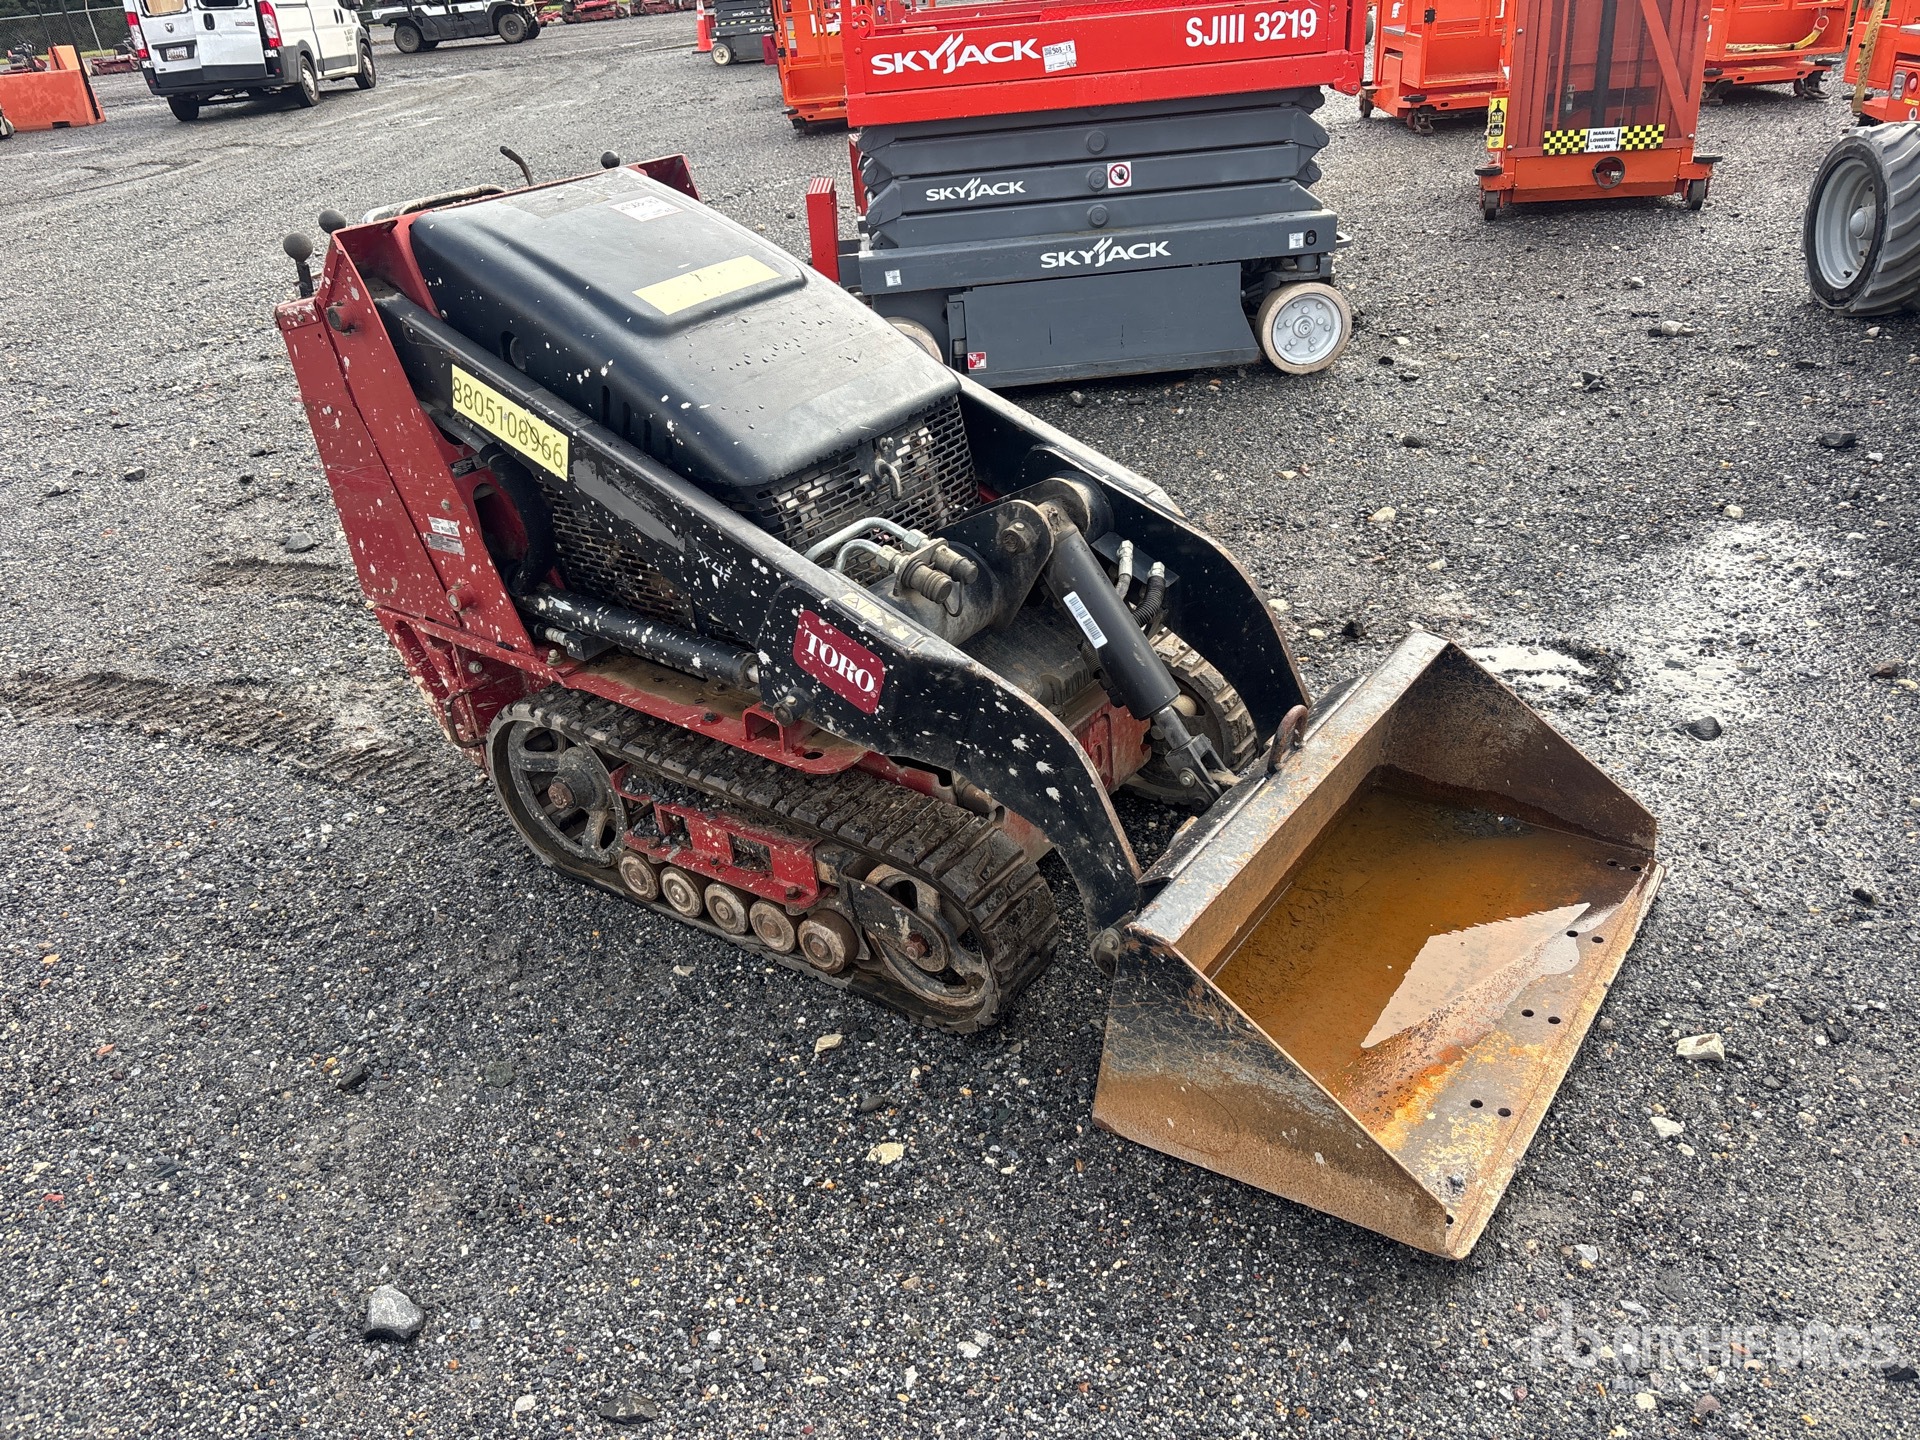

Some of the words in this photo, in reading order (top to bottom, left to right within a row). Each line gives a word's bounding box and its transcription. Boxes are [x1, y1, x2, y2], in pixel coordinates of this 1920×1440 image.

[1185, 14, 1245, 47] SJIII
[1254, 8, 1317, 42] 3219
[870, 32, 1043, 75] SKYJACK
[925, 177, 1027, 202] SKYJACK
[1040, 237, 1172, 269] SKYJACK
[453, 376, 564, 469] 8805108966
[803, 628, 875, 693] TORO
